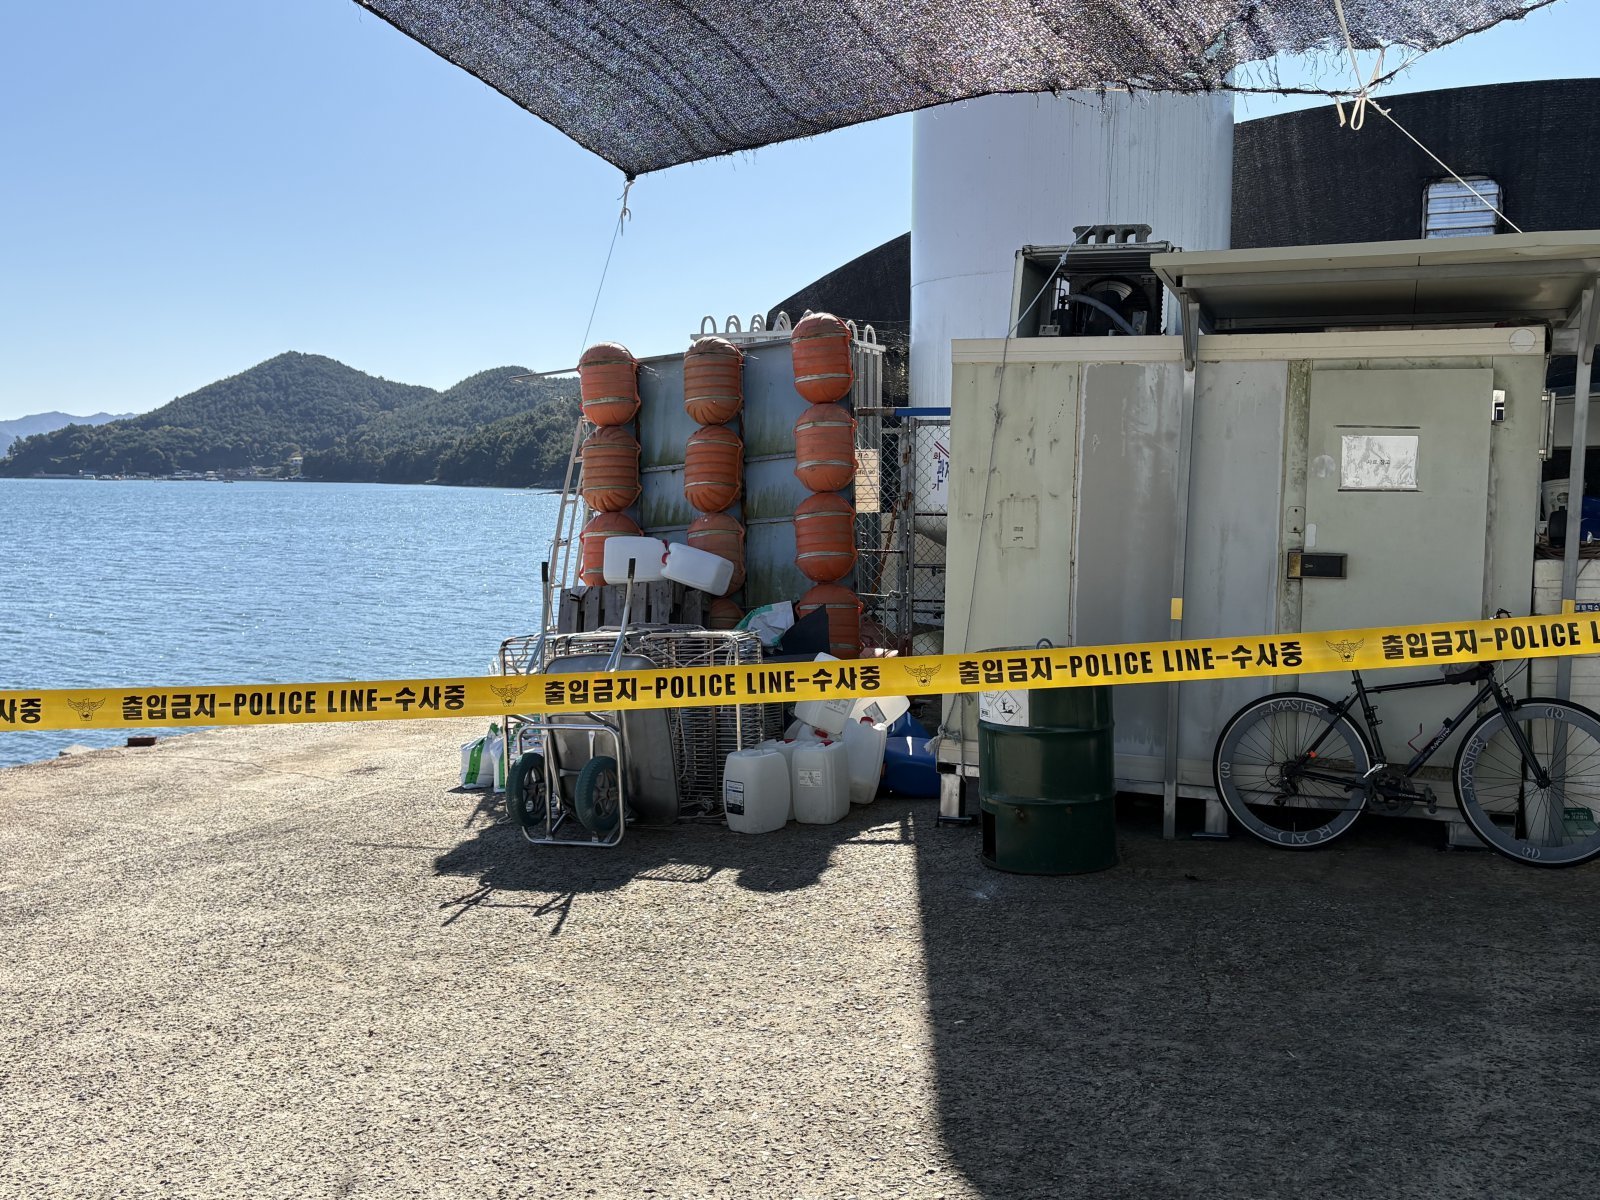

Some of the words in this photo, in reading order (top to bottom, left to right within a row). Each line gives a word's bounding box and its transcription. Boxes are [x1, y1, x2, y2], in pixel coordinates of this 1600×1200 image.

[1381, 622, 1581, 660] 출입금지-POLICE
[958, 650, 1153, 685] 출입금지-POLICE
[1162, 641, 1303, 673] LINE-수사중
[121, 690, 317, 721] 출입금지-POLICE
[327, 684, 466, 713] LINE-수사중
[544, 673, 736, 706] 출입금지-POLICE
[746, 665, 881, 695] LINE-수사중
[1270, 699, 1322, 715] MASTER
[1431, 728, 1451, 750] MASTER
[1462, 737, 1484, 789] MASTER
